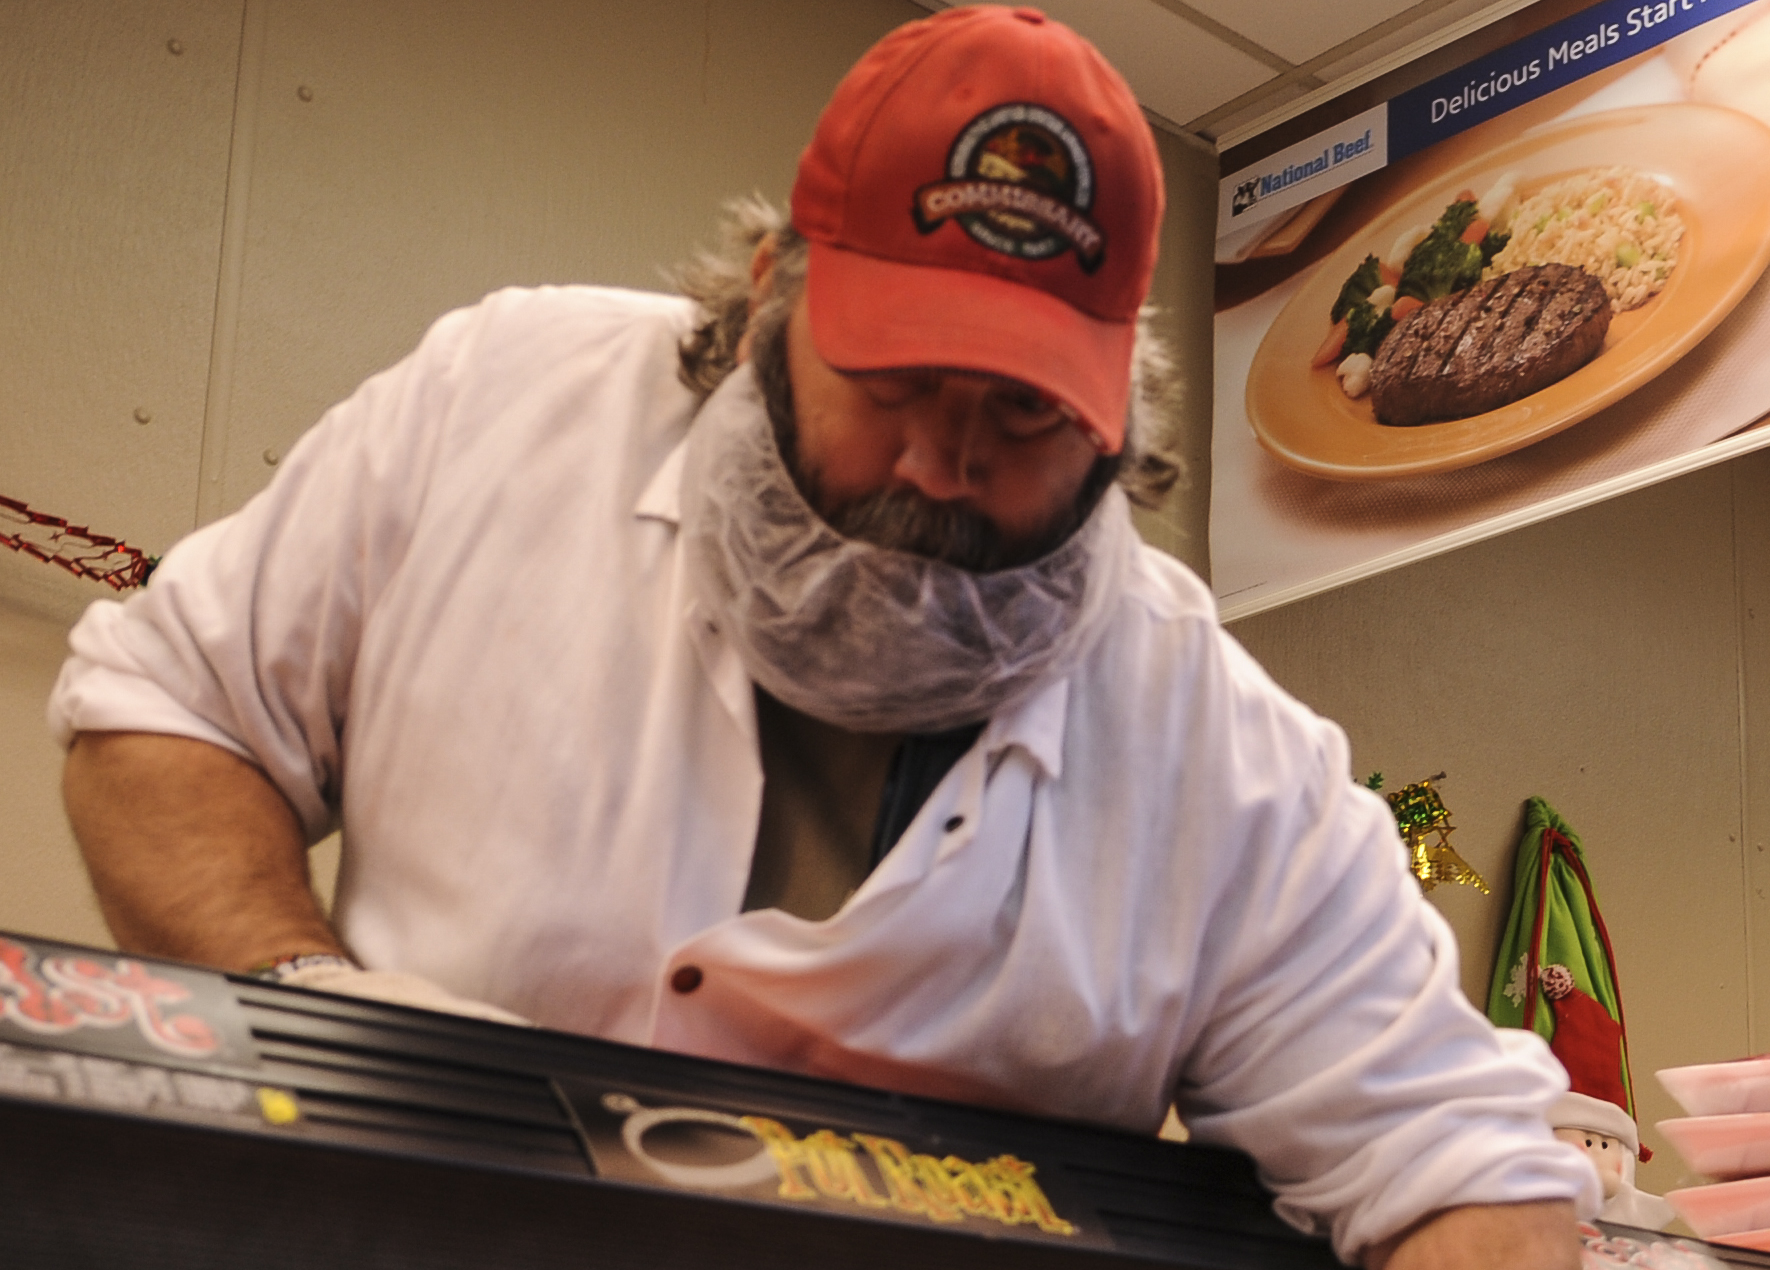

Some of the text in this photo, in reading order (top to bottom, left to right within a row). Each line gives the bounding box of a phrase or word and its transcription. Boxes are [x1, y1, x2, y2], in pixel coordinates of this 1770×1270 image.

[1430, 0, 1694, 124] Delicious Meals Start
[1259, 129, 1372, 197] National Beef
